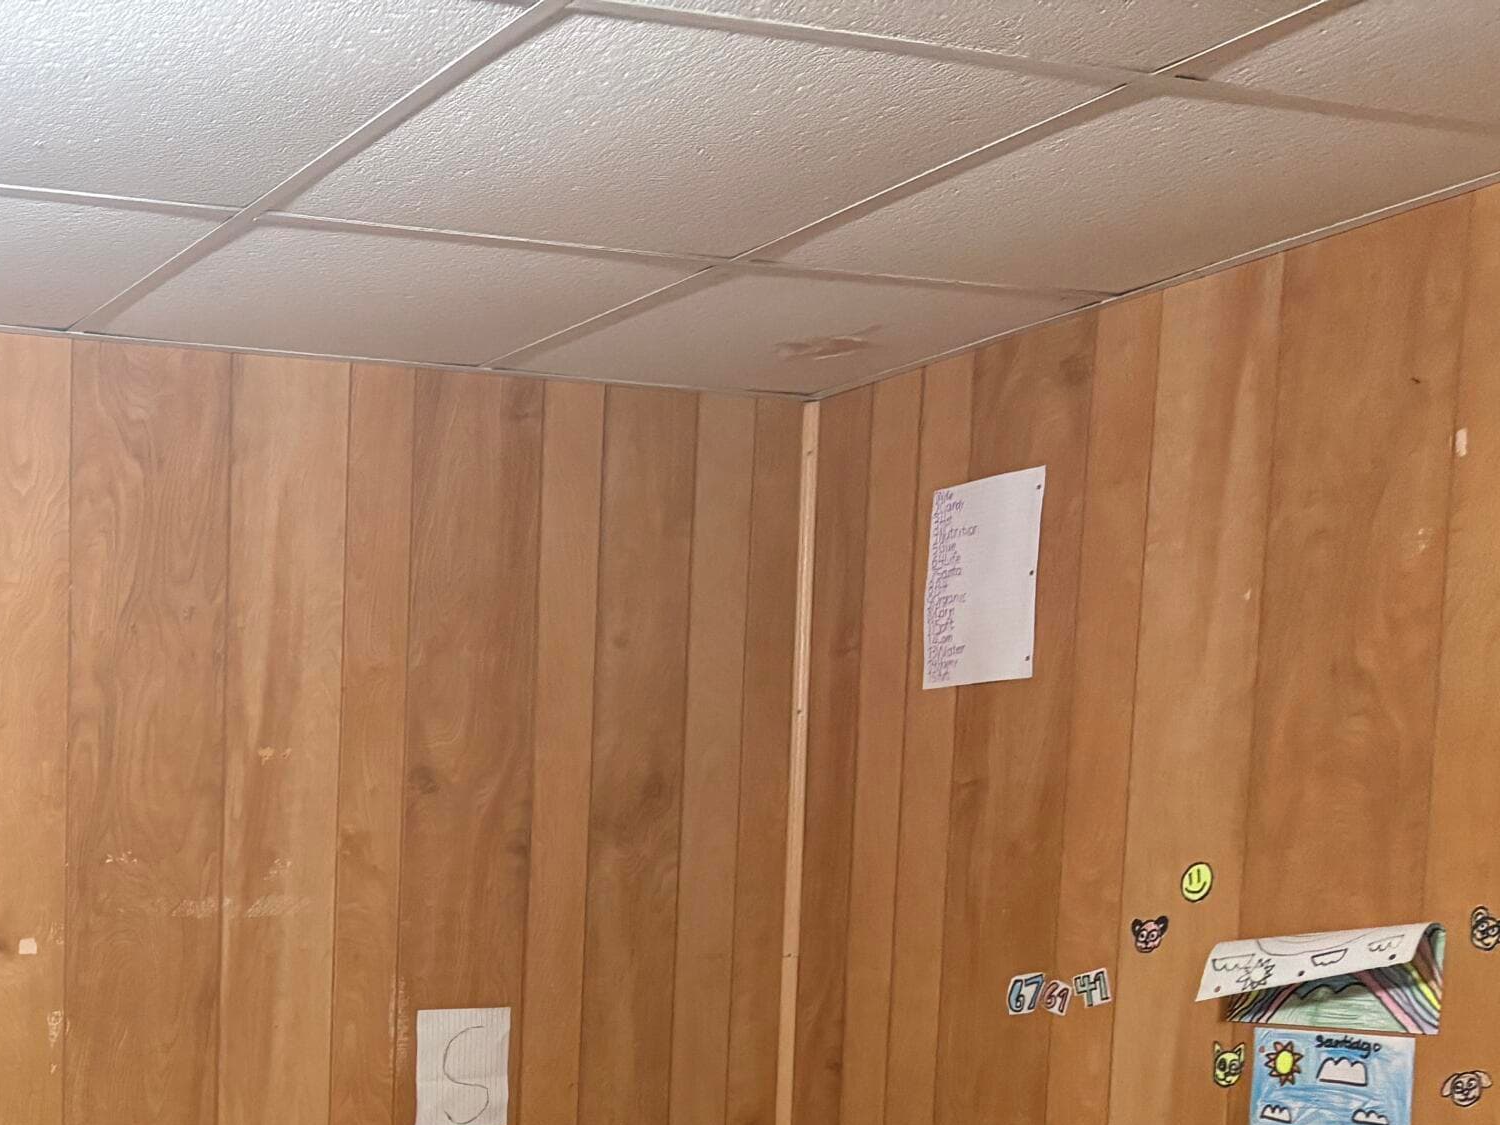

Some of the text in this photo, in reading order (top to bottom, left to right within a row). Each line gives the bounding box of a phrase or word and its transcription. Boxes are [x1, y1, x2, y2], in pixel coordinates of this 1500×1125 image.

[1008, 974, 1044, 1012] 67
[1074, 971, 1109, 1007] 41
[442, 1025, 490, 1125] S
